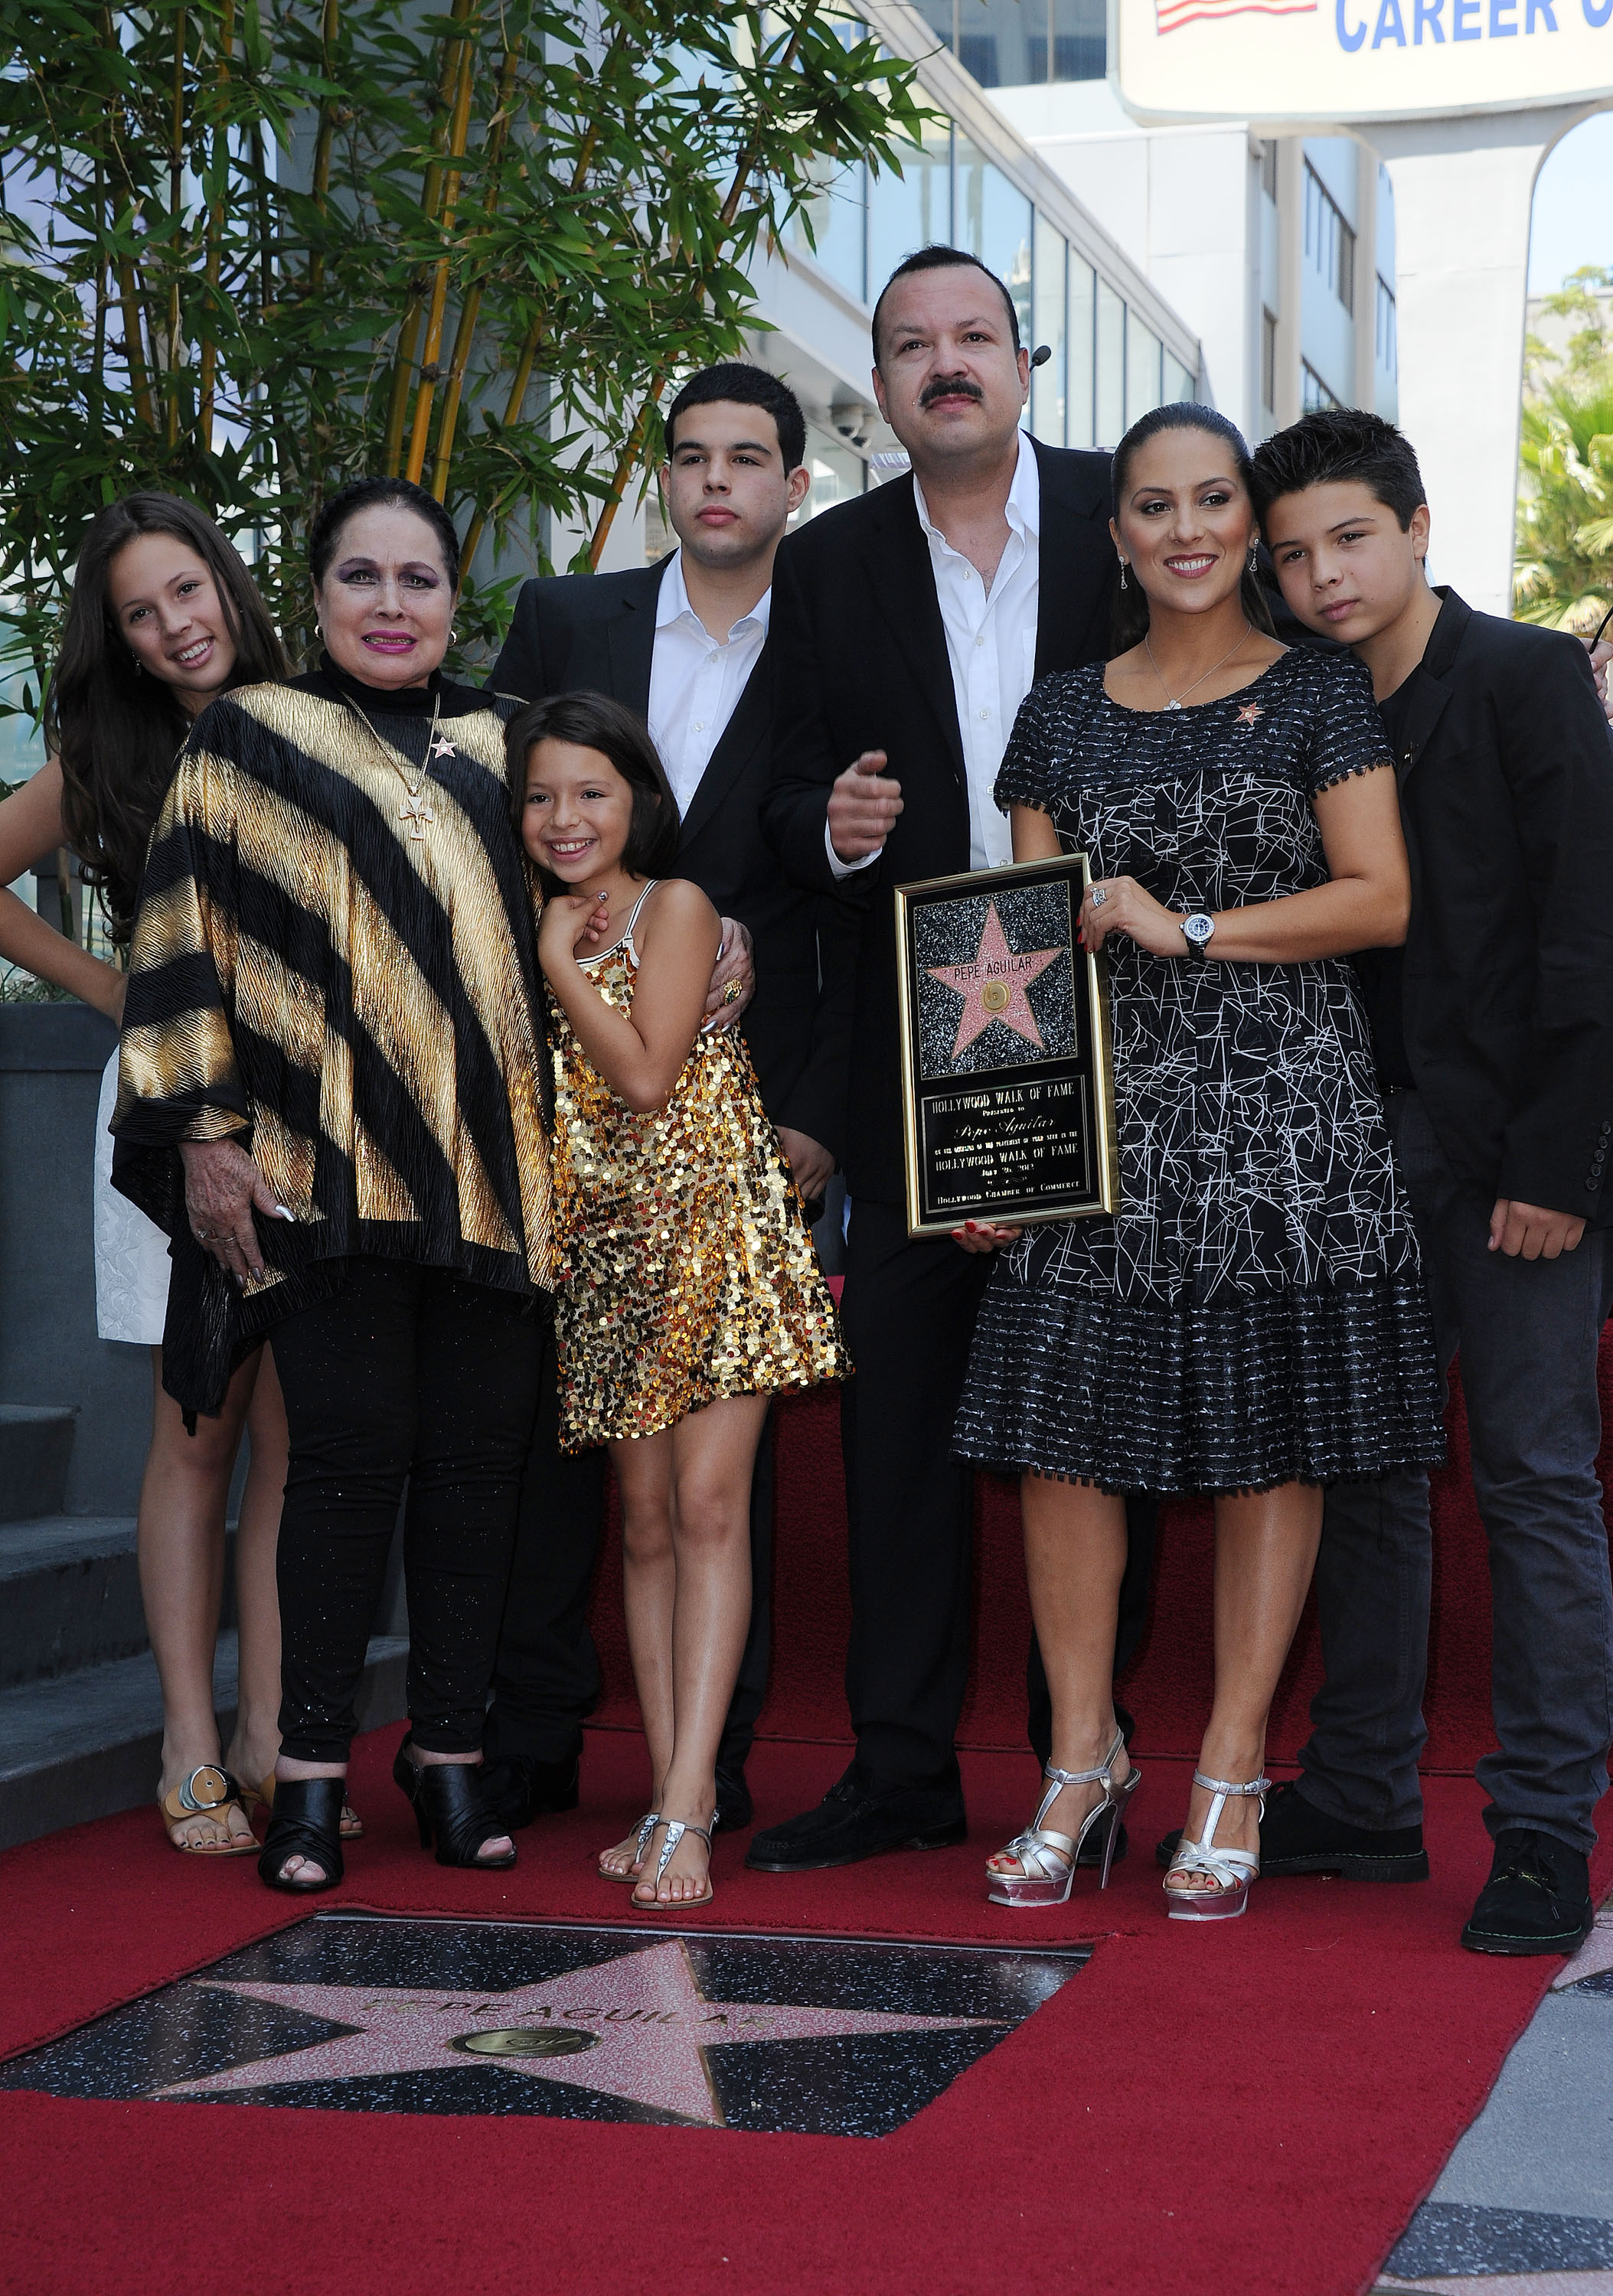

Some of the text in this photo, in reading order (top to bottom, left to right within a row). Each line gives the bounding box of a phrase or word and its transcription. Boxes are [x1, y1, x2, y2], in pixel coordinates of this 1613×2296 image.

[1335, 0, 1559, 53] CAREER
[954, 956, 1033, 980] PEPE AGUILAR
[932, 1082, 1075, 1114] HOLLYWOOD WALK OF FAME
[954, 1114, 1056, 1141] Pepe Aguilar
[935, 1154, 994, 1172] HOLLYWOOD
[999, 1148, 1027, 1163] WALK
[1033, 1146, 1046, 1159] OF
[1051, 1143, 1079, 1156] FAME
[362, 1999, 776, 2029] PEPE AGUILAR
